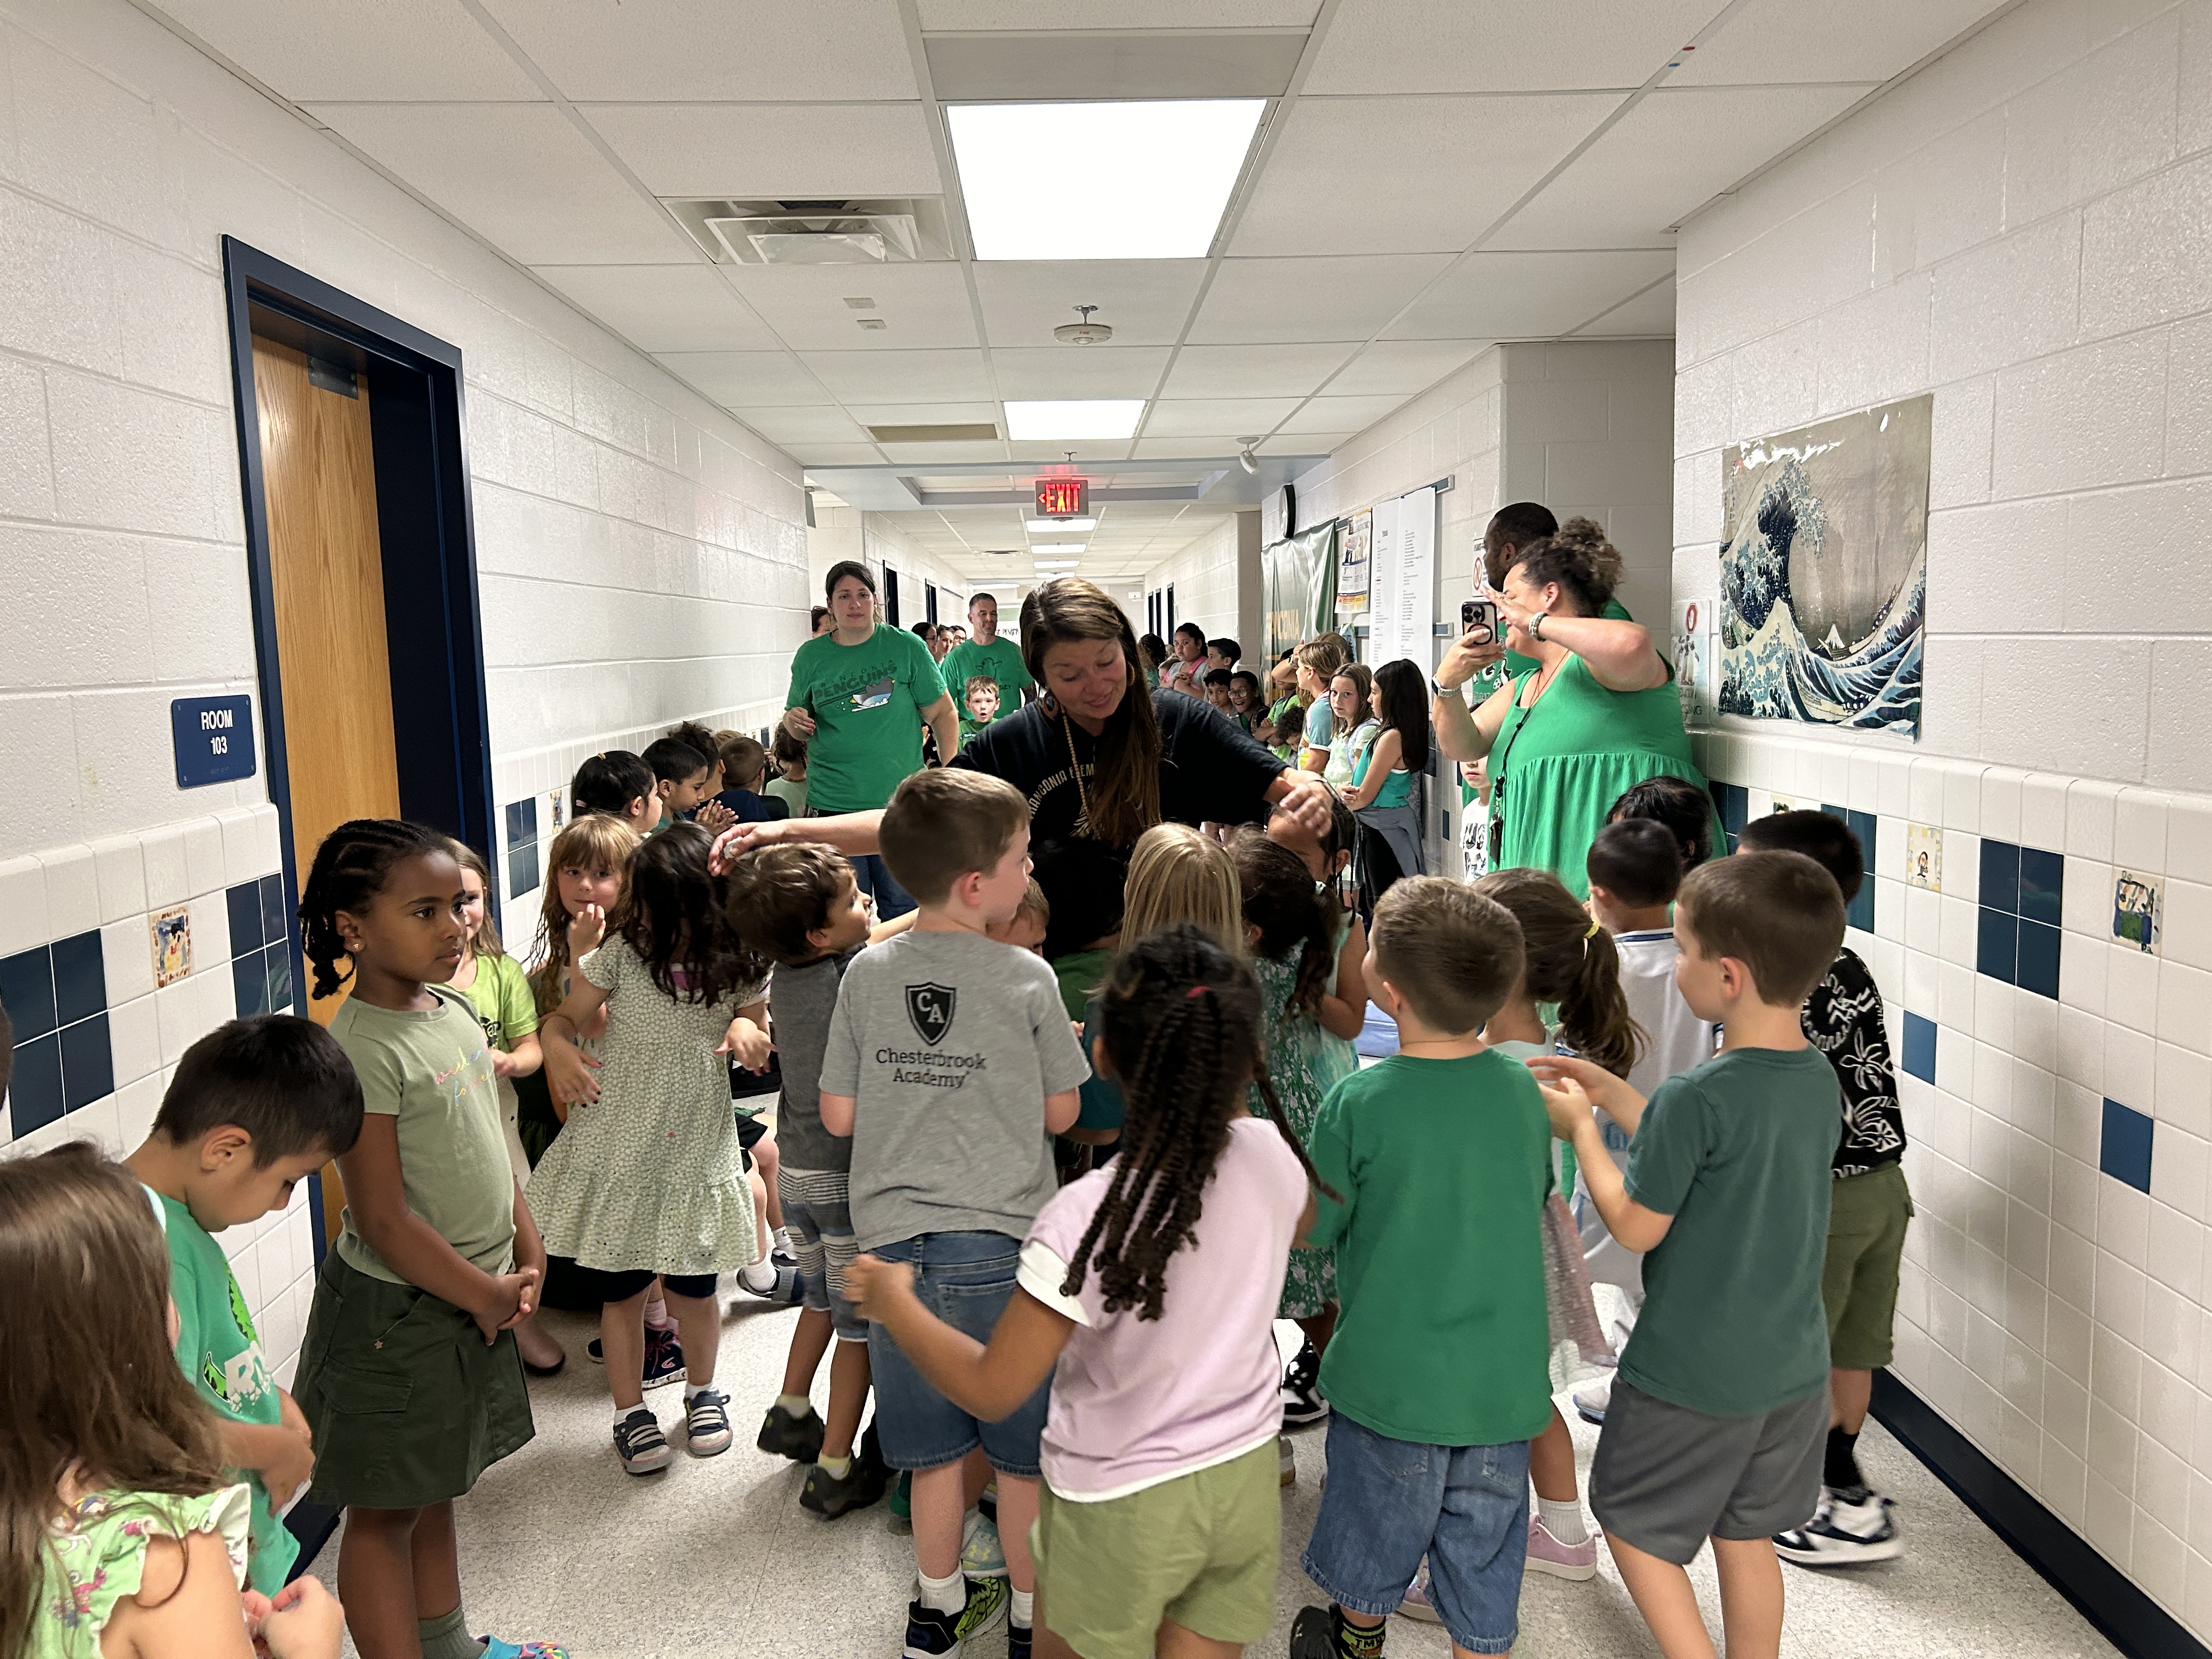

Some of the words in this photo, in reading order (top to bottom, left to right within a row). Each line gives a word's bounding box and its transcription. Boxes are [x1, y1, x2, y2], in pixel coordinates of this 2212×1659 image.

[1045, 483, 1081, 512] EXIT
[201, 709, 233, 730] ROOM
[210, 736, 228, 755] 103
[1030, 770, 1068, 820] RANCONIA
[876, 1047, 987, 1070] Chesterbrook
[893, 1068, 966, 1089] Academy
